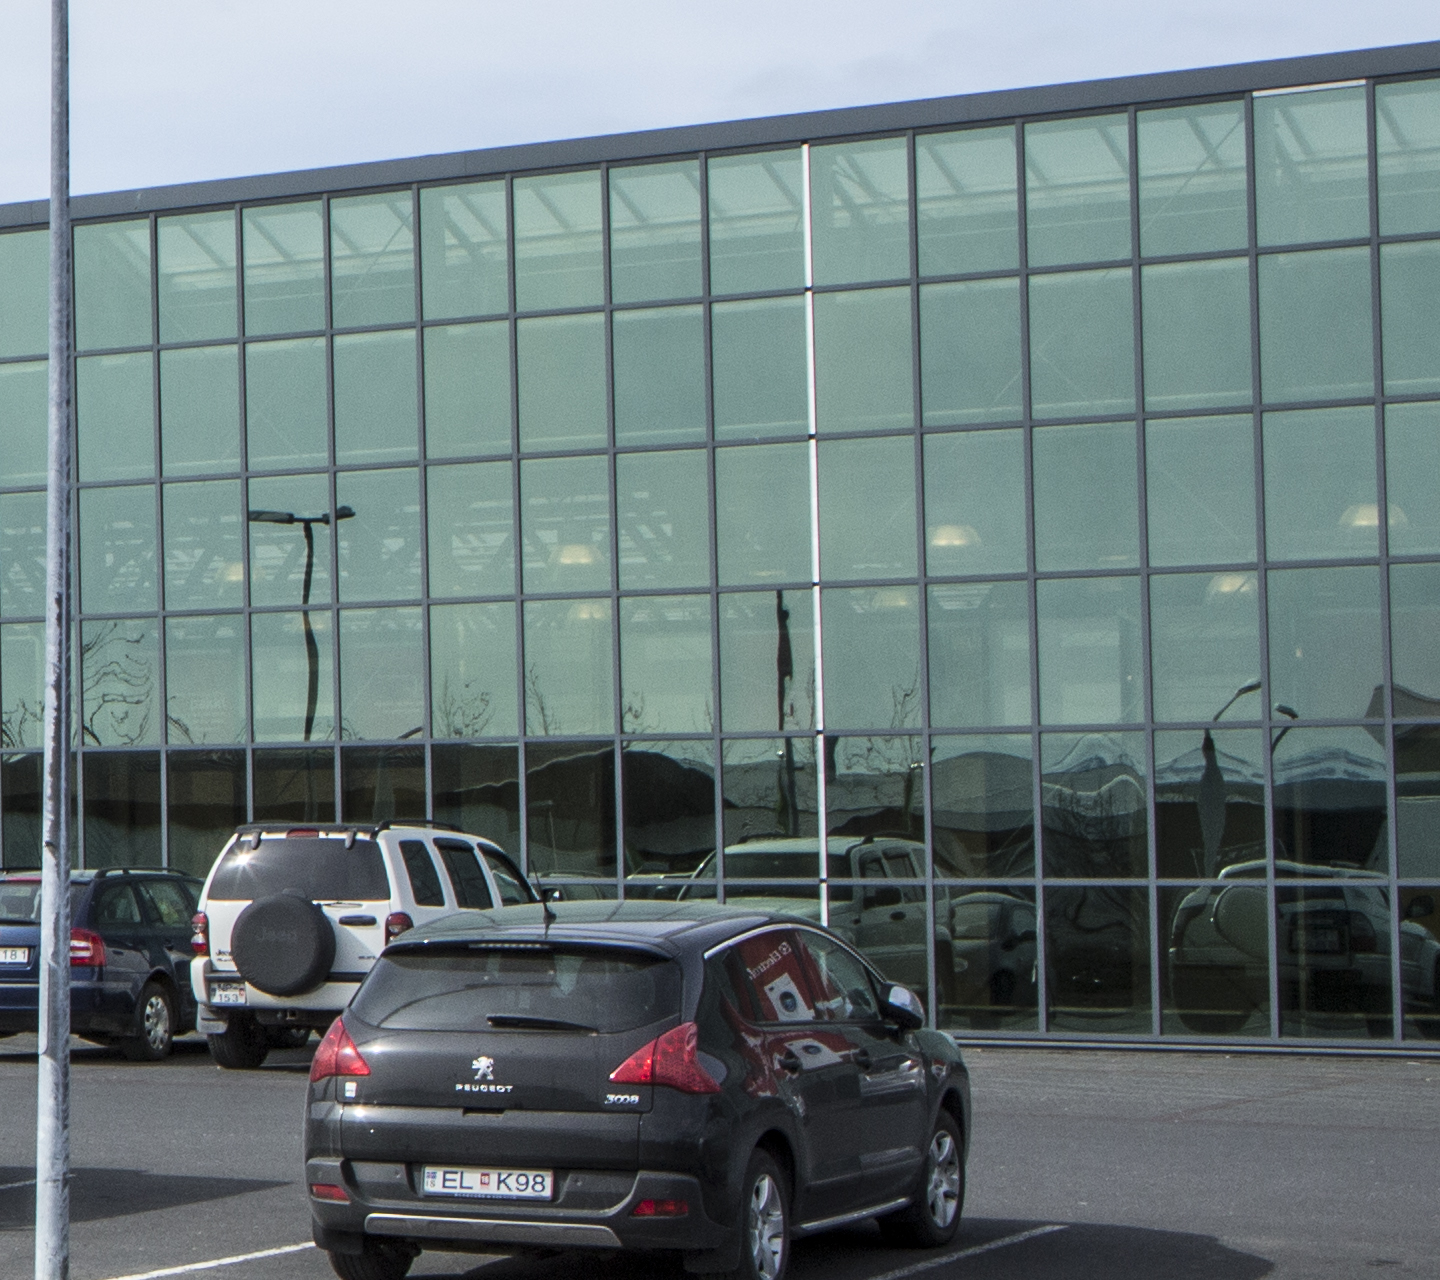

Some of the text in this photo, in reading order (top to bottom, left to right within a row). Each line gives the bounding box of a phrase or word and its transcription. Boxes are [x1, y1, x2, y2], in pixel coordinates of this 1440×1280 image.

[455, 1083, 514, 1093] PEUGEOT
[604, 1093, 640, 1104] 3008
[442, 1170, 474, 1190] EL
[496, 1171, 546, 1193] K98
